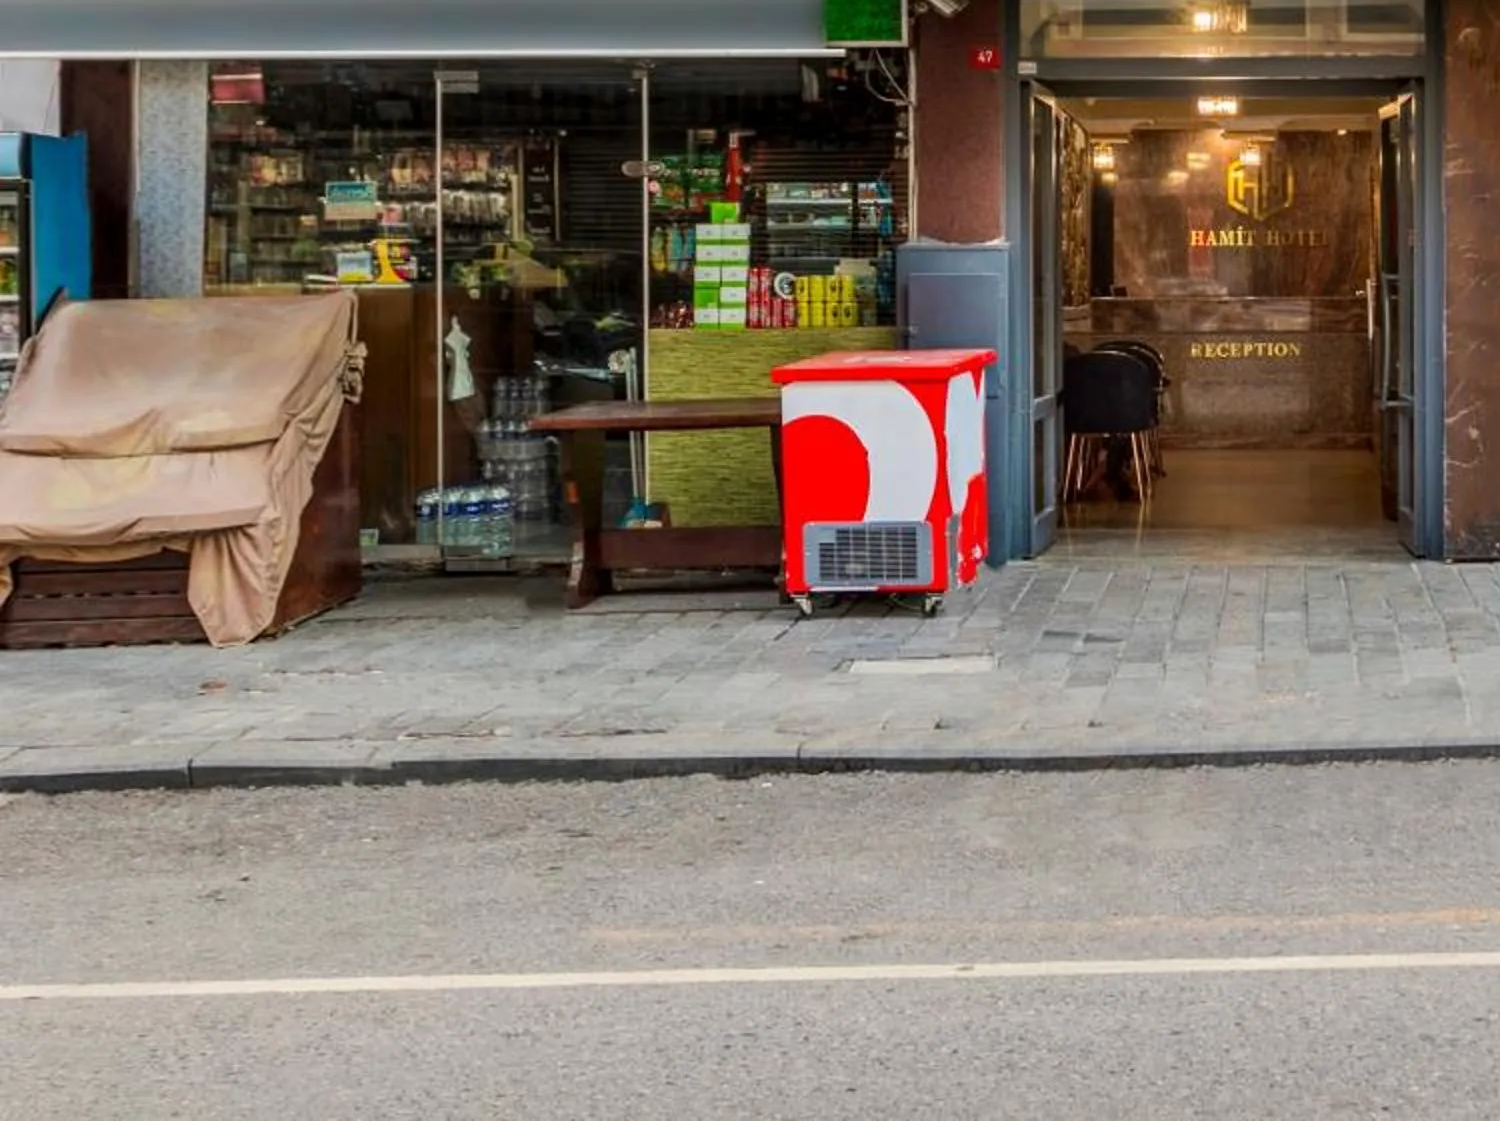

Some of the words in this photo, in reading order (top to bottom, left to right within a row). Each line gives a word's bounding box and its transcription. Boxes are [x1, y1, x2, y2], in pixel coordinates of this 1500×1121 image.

[977, 50, 993, 64] 47
[1189, 226, 1256, 247] HAMİT
[1190, 341, 1302, 359] RECEPTION
